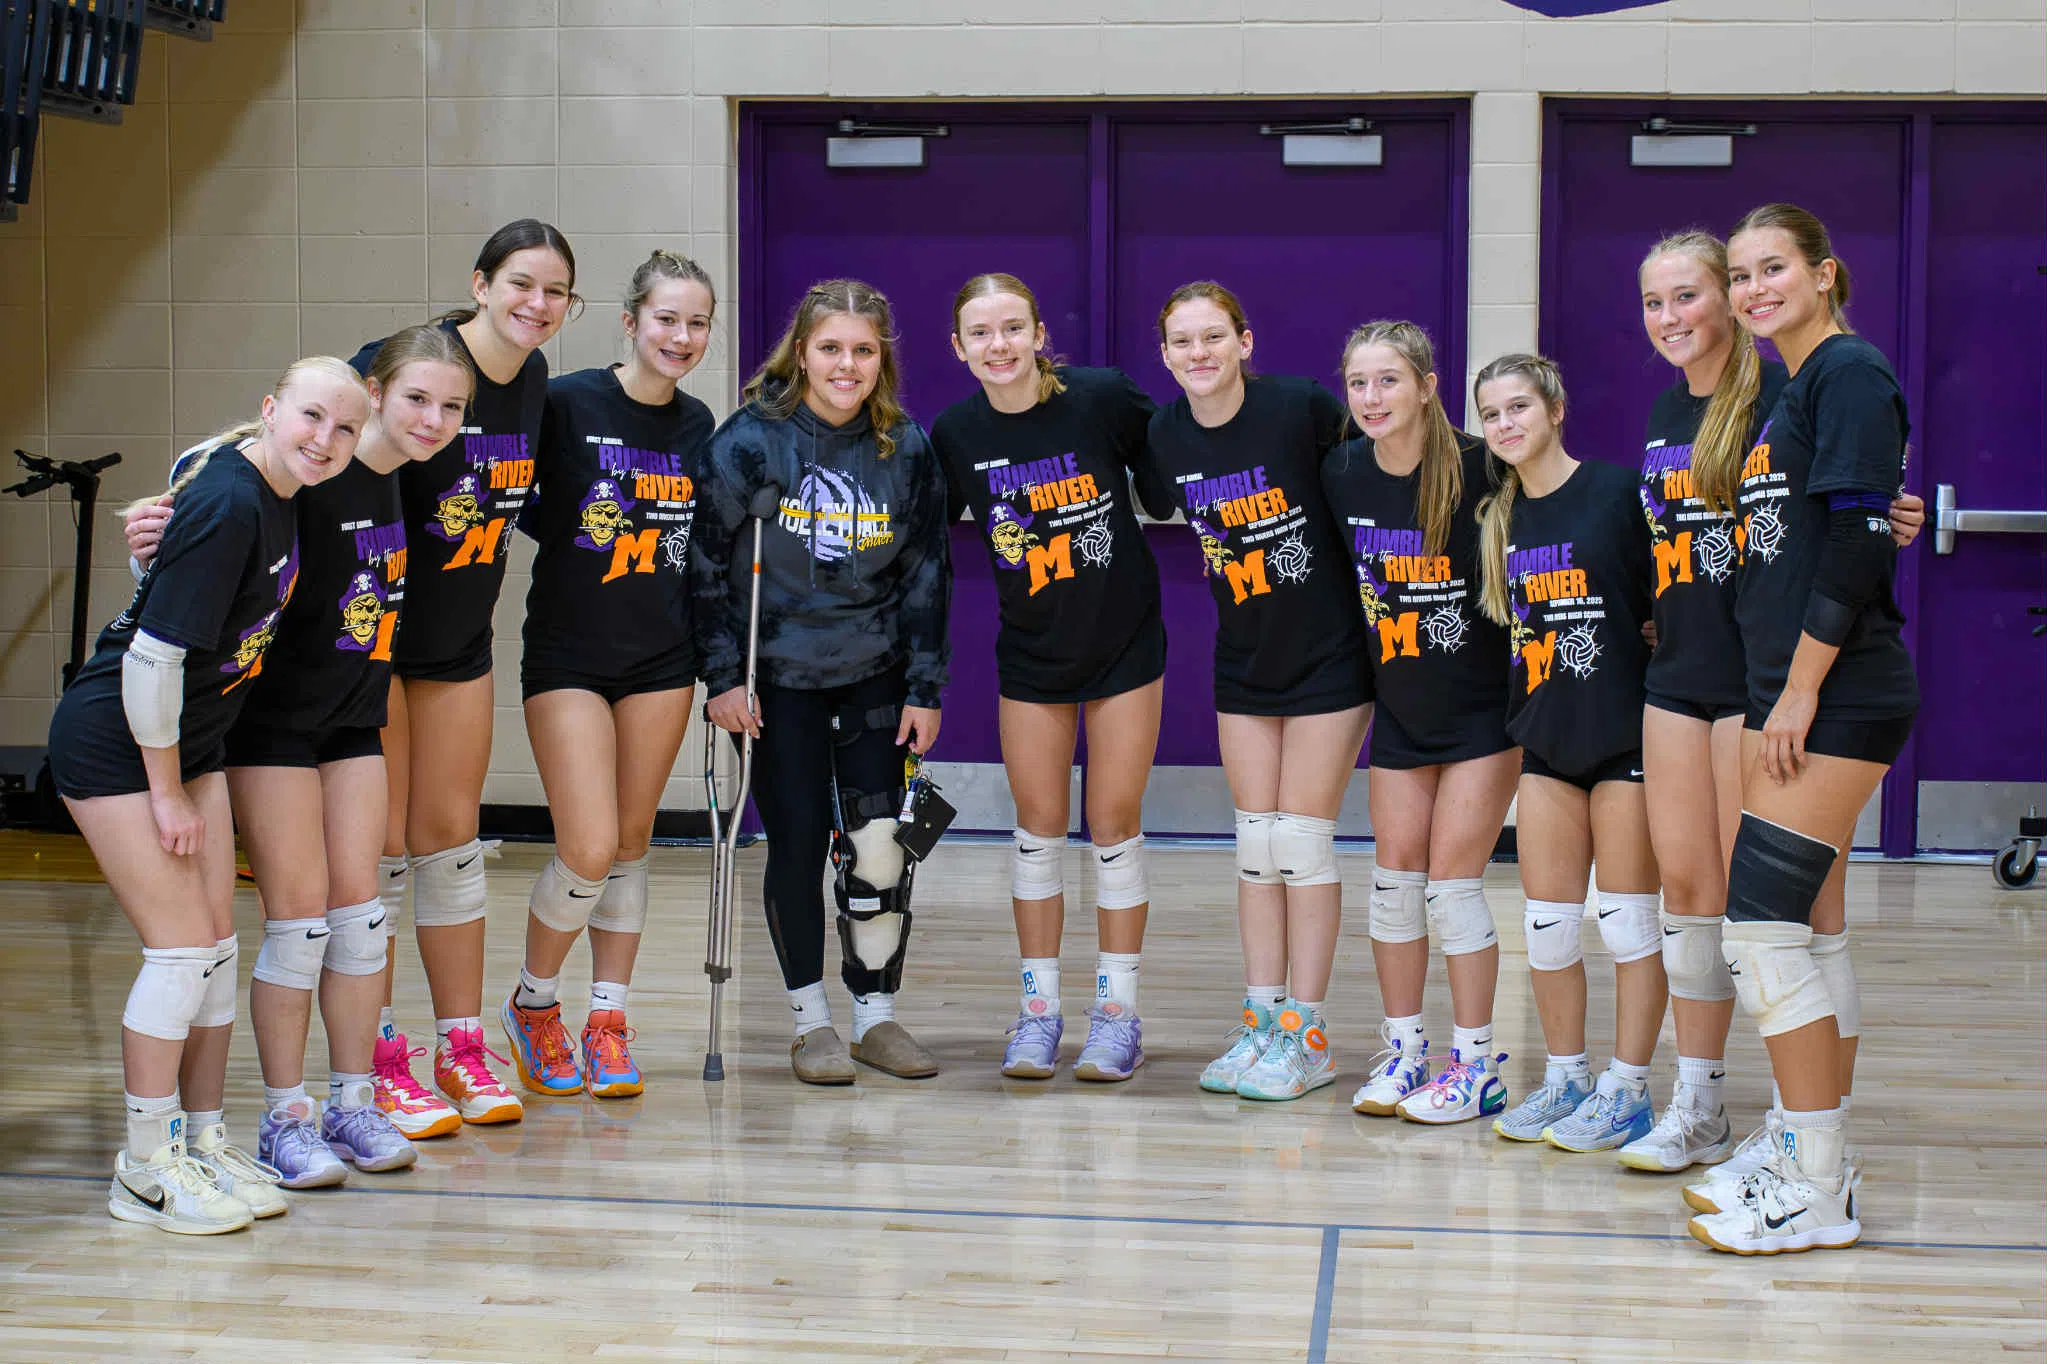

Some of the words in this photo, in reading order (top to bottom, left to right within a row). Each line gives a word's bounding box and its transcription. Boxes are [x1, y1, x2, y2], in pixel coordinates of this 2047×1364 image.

[465, 433, 530, 463] RUMBLE
[474, 454, 484, 473] by
[598, 444, 683, 476] RUMBLE
[611, 463, 626, 480] by
[635, 473, 694, 502] RIVER
[988, 451, 1080, 494] RUMBLE
[1184, 465, 1270, 509] RUMBLE
[1001, 484, 1017, 501] by
[1029, 473, 1099, 512] RIVER
[1194, 500, 1208, 517] by
[1219, 487, 1289, 528] RIVER
[441, 517, 506, 571] M
[602, 529, 661, 584] M
[1355, 526, 1424, 556] RUMBL
[1362, 545, 1375, 564] by
[1378, 550, 1394, 562] the
[1025, 532, 1075, 597] M
[1224, 549, 1272, 606] M
[1384, 555, 1452, 582] RIVER
[1653, 531, 1693, 600] M
[1399, 595, 1411, 603] TWO
[1525, 568, 1588, 603] RIVER
[1586, 596, 1603, 605] 2025
[1568, 611, 1583, 620] HIGH
[1583, 610, 1606, 619] SCHOOL
[1377, 612, 1420, 665] M
[1522, 630, 1557, 695] M
